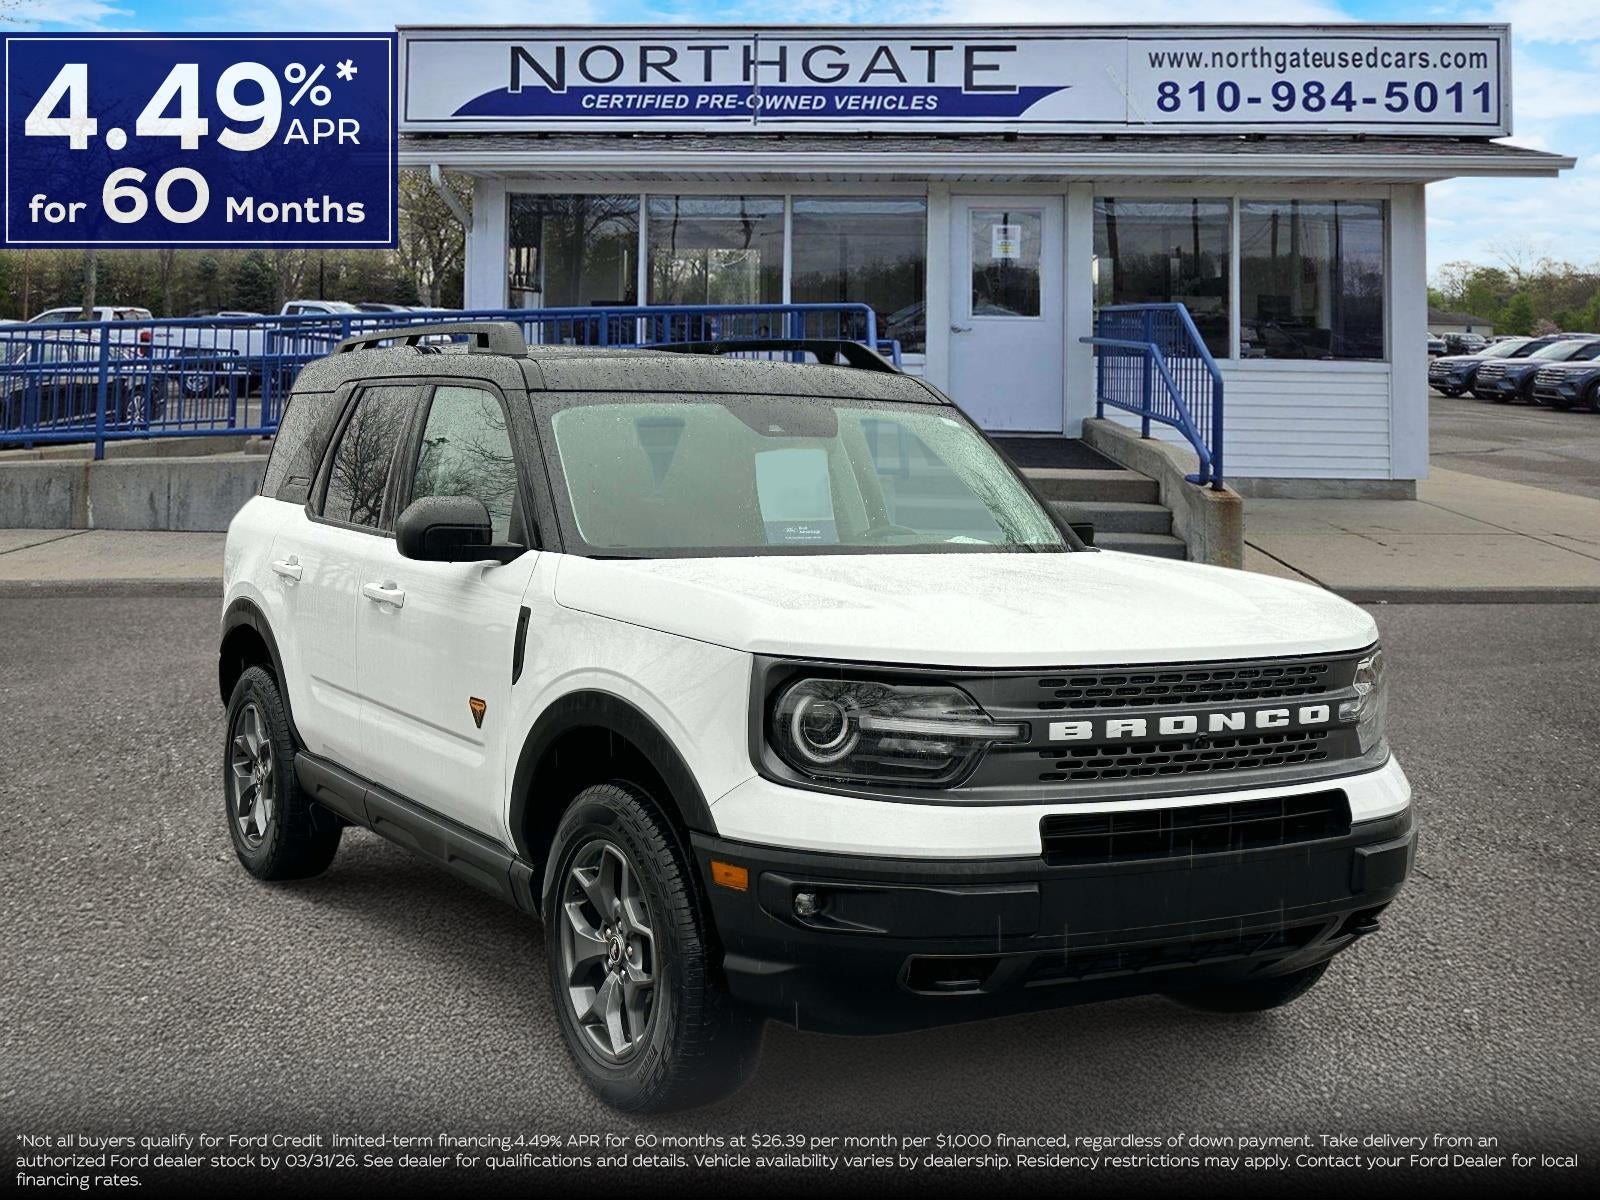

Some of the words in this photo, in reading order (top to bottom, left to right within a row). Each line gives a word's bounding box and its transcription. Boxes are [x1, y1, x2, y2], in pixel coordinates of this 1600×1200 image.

[510, 45, 1017, 93] NORTHGATE
[1148, 47, 1488, 73] www.northgateusedcars.com
[581, 94, 689, 109] CERTIFIED
[695, 94, 826, 110] PRE-OWNED
[834, 95, 939, 110] VEHICLES
[1156, 80, 1491, 113] 810-984-5011
[1049, 704, 1330, 741] BRONCO
